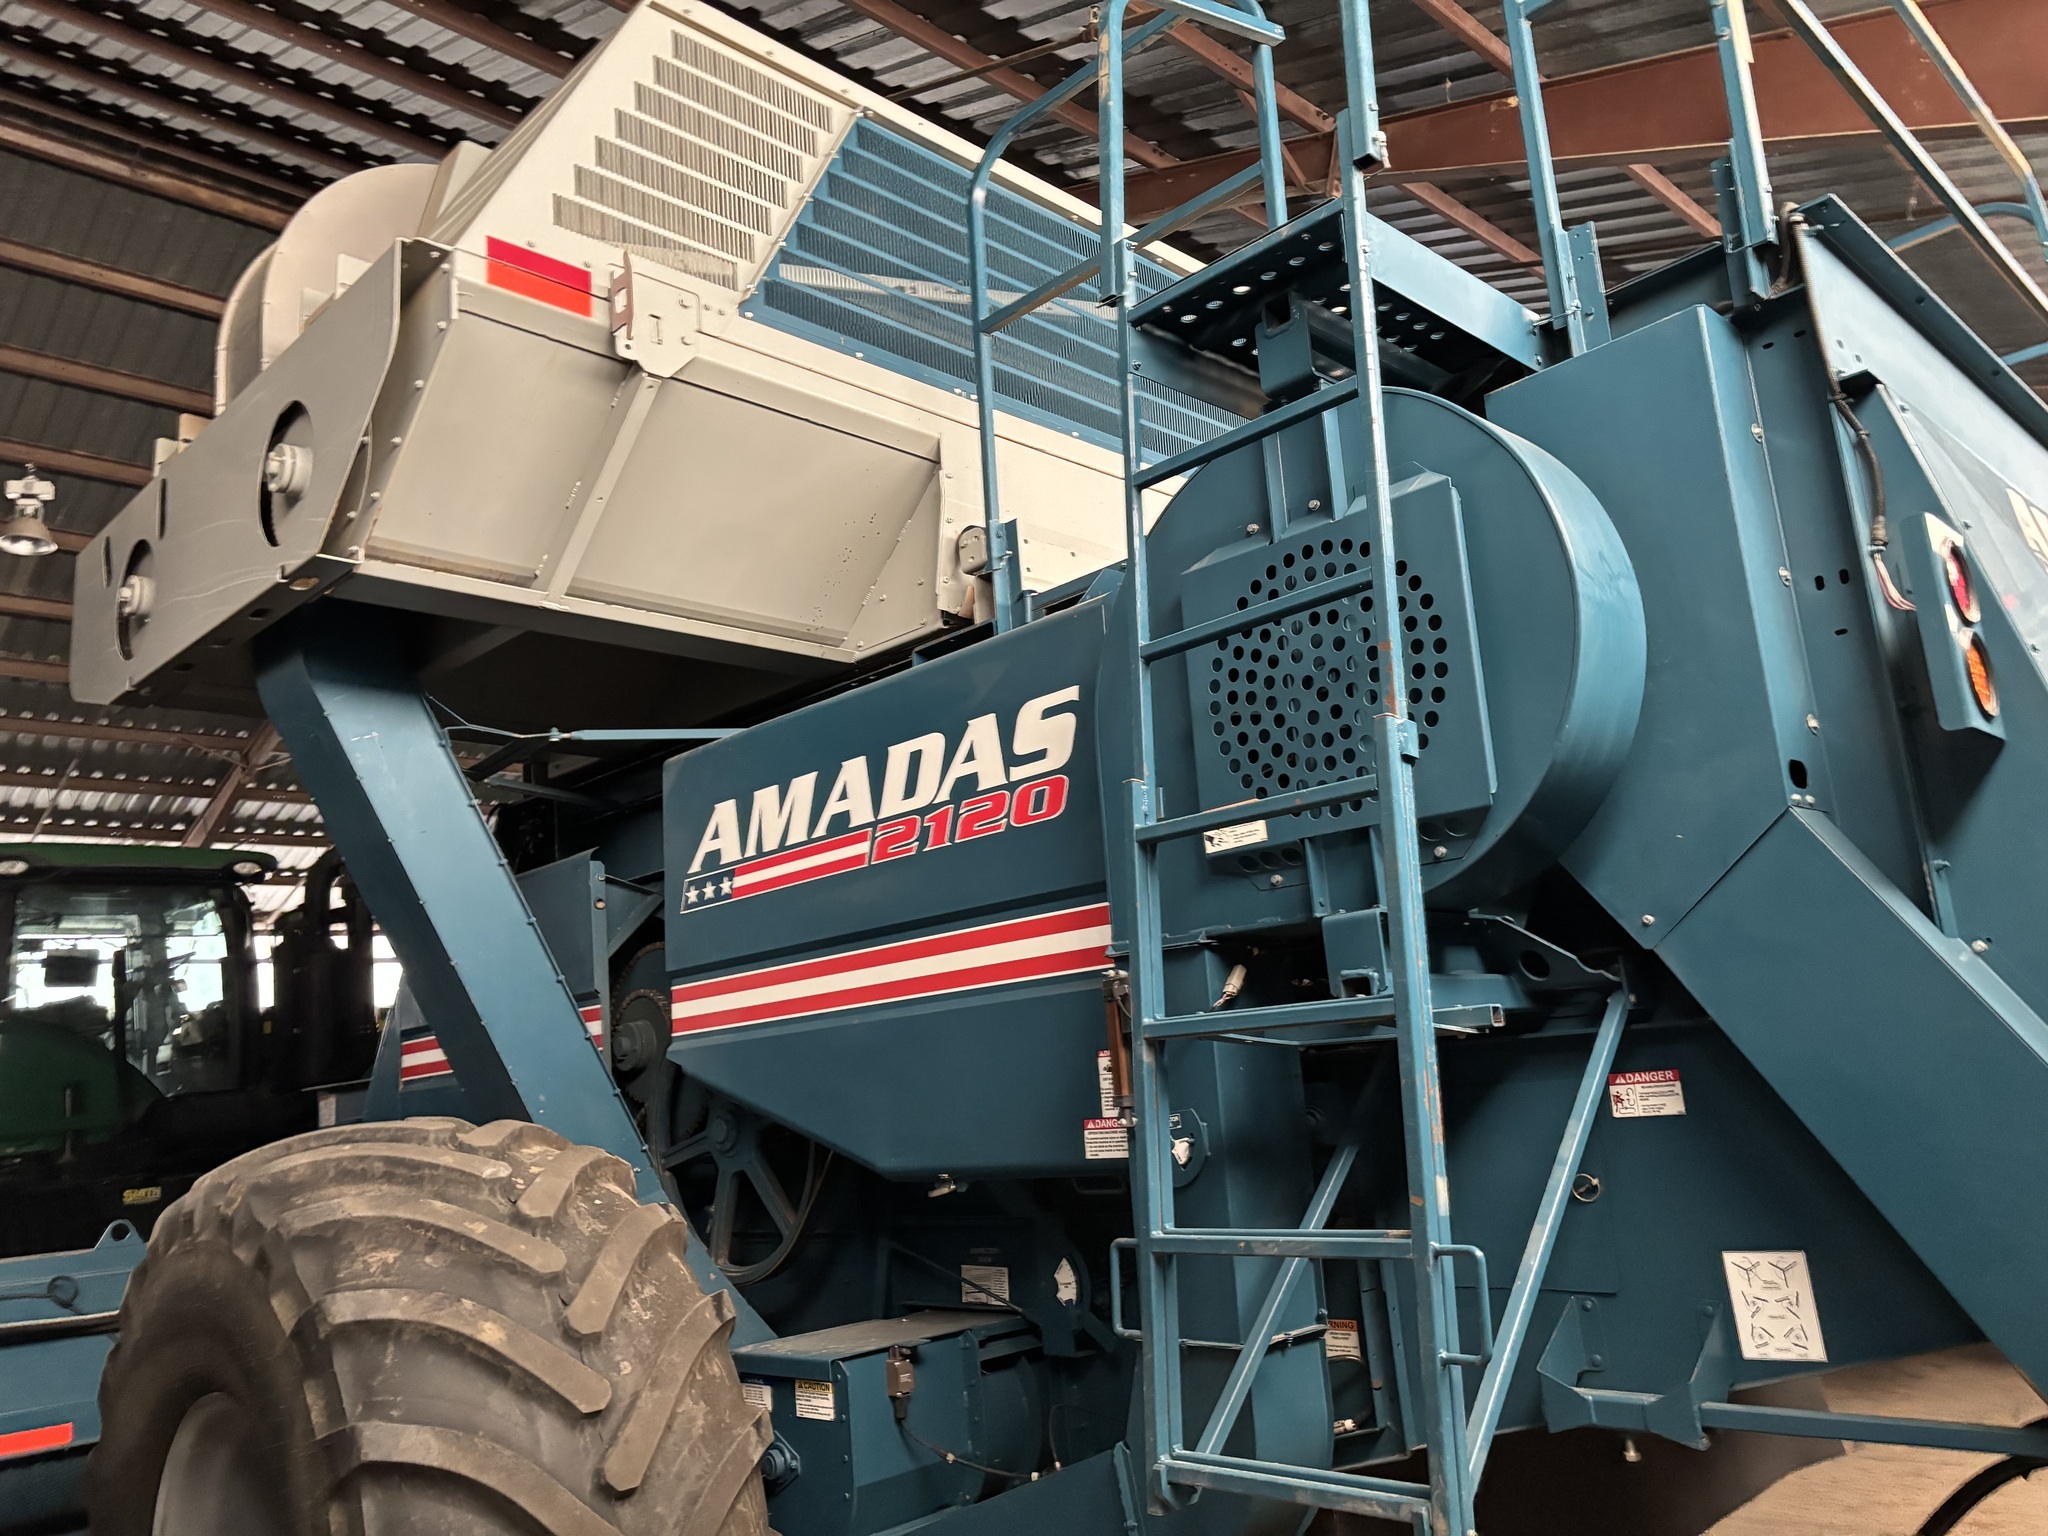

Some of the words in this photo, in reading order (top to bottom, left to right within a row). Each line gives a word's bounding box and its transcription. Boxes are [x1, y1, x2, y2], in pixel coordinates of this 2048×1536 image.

[687, 685, 1080, 874] AMADAS
[871, 775, 1069, 865] 2120
[1625, 1070, 1675, 1083] DANGER
[1095, 1118, 1120, 1128] DANG
[1327, 1320, 1355, 1330] RNING
[803, 1381, 830, 1392] CAUTION
